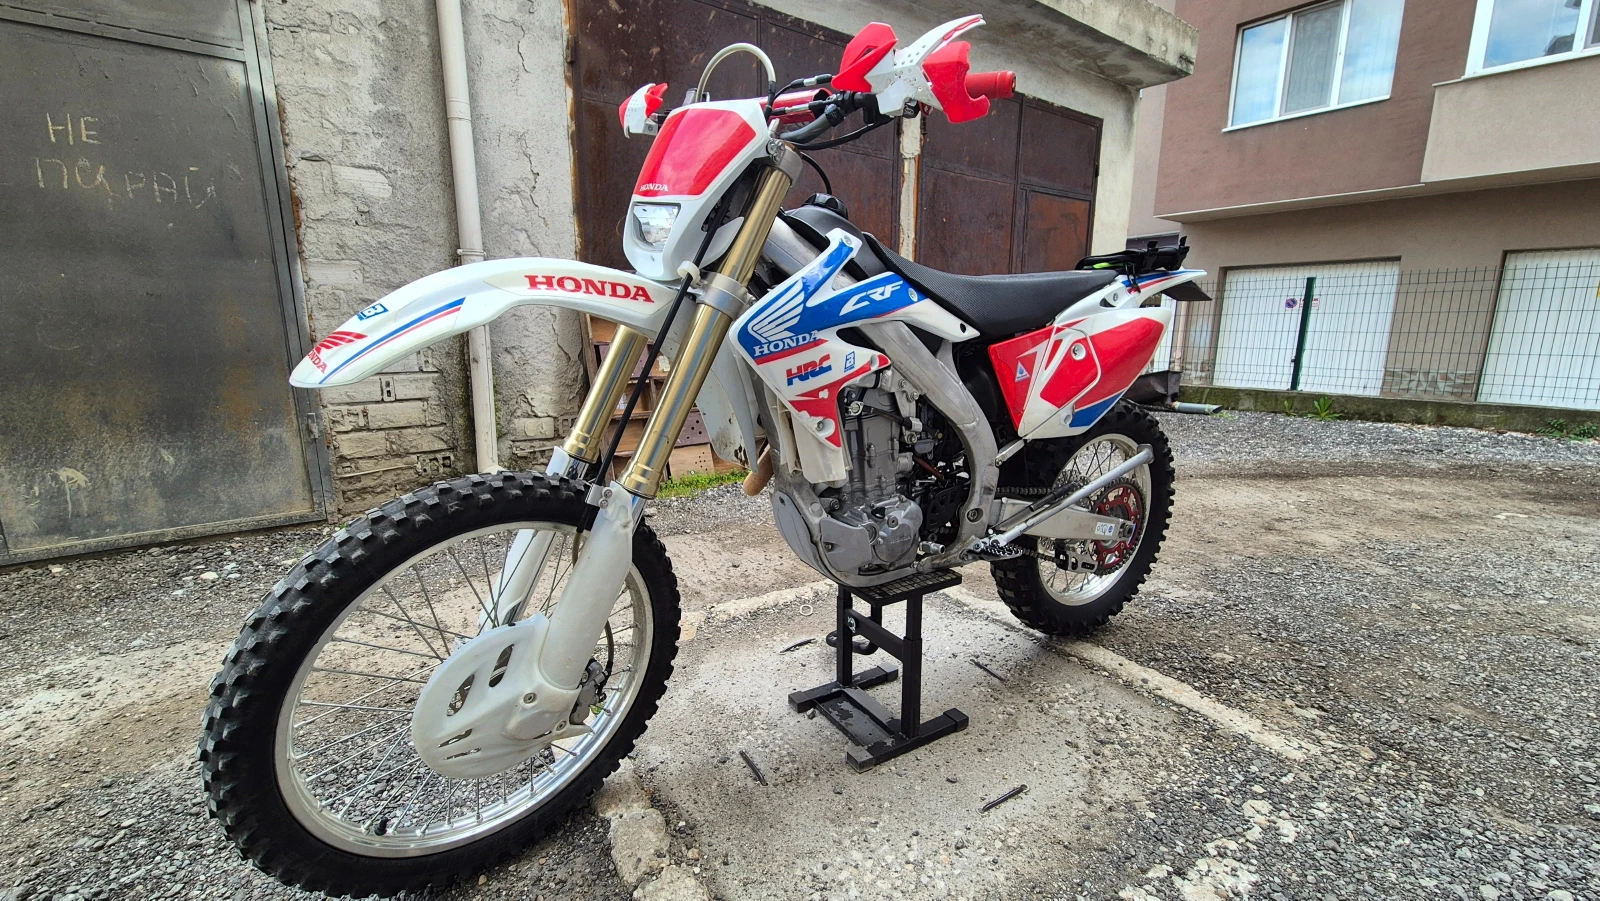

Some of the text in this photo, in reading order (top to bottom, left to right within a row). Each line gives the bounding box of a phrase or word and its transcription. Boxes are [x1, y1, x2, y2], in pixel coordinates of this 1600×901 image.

[46, 112, 101, 145] НЕ
[639, 183, 669, 192] HONDA
[524, 275, 655, 303] HONDA
[839, 280, 903, 316] CRF
[753, 330, 820, 357] HONDA
[786, 353, 832, 387] HRC
